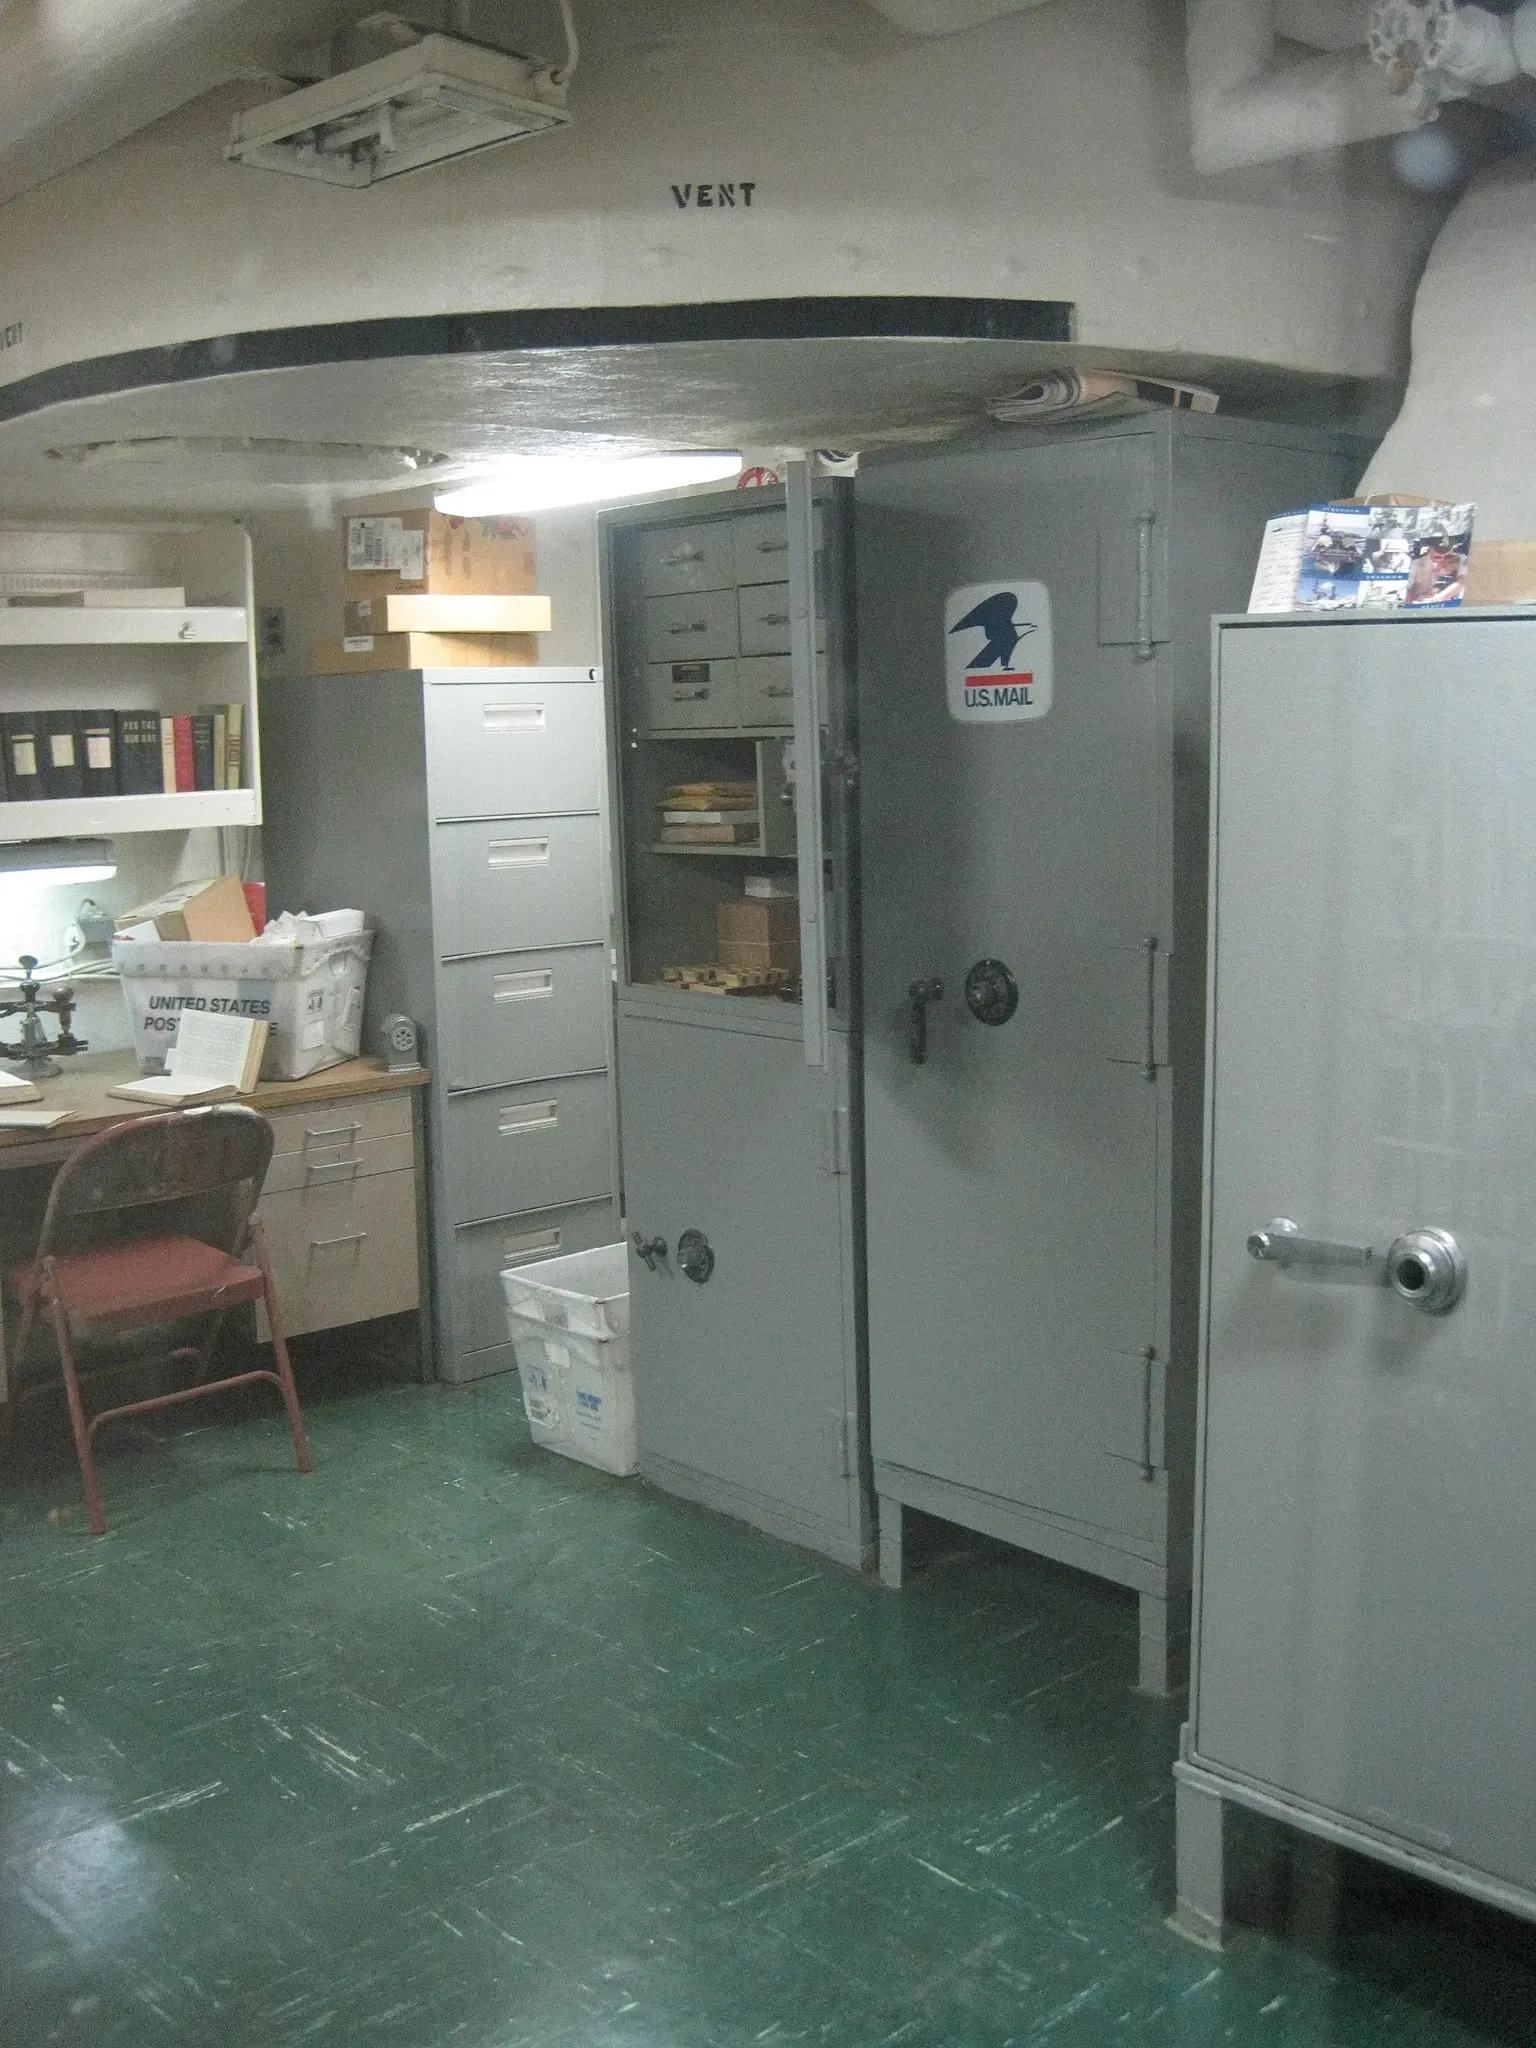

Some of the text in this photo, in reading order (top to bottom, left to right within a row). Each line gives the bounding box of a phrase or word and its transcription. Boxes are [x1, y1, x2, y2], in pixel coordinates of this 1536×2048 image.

[671, 183, 756, 209] VENT
[149, 995, 272, 1014] UNITED STATES
[144, 1016, 181, 1031] POS
